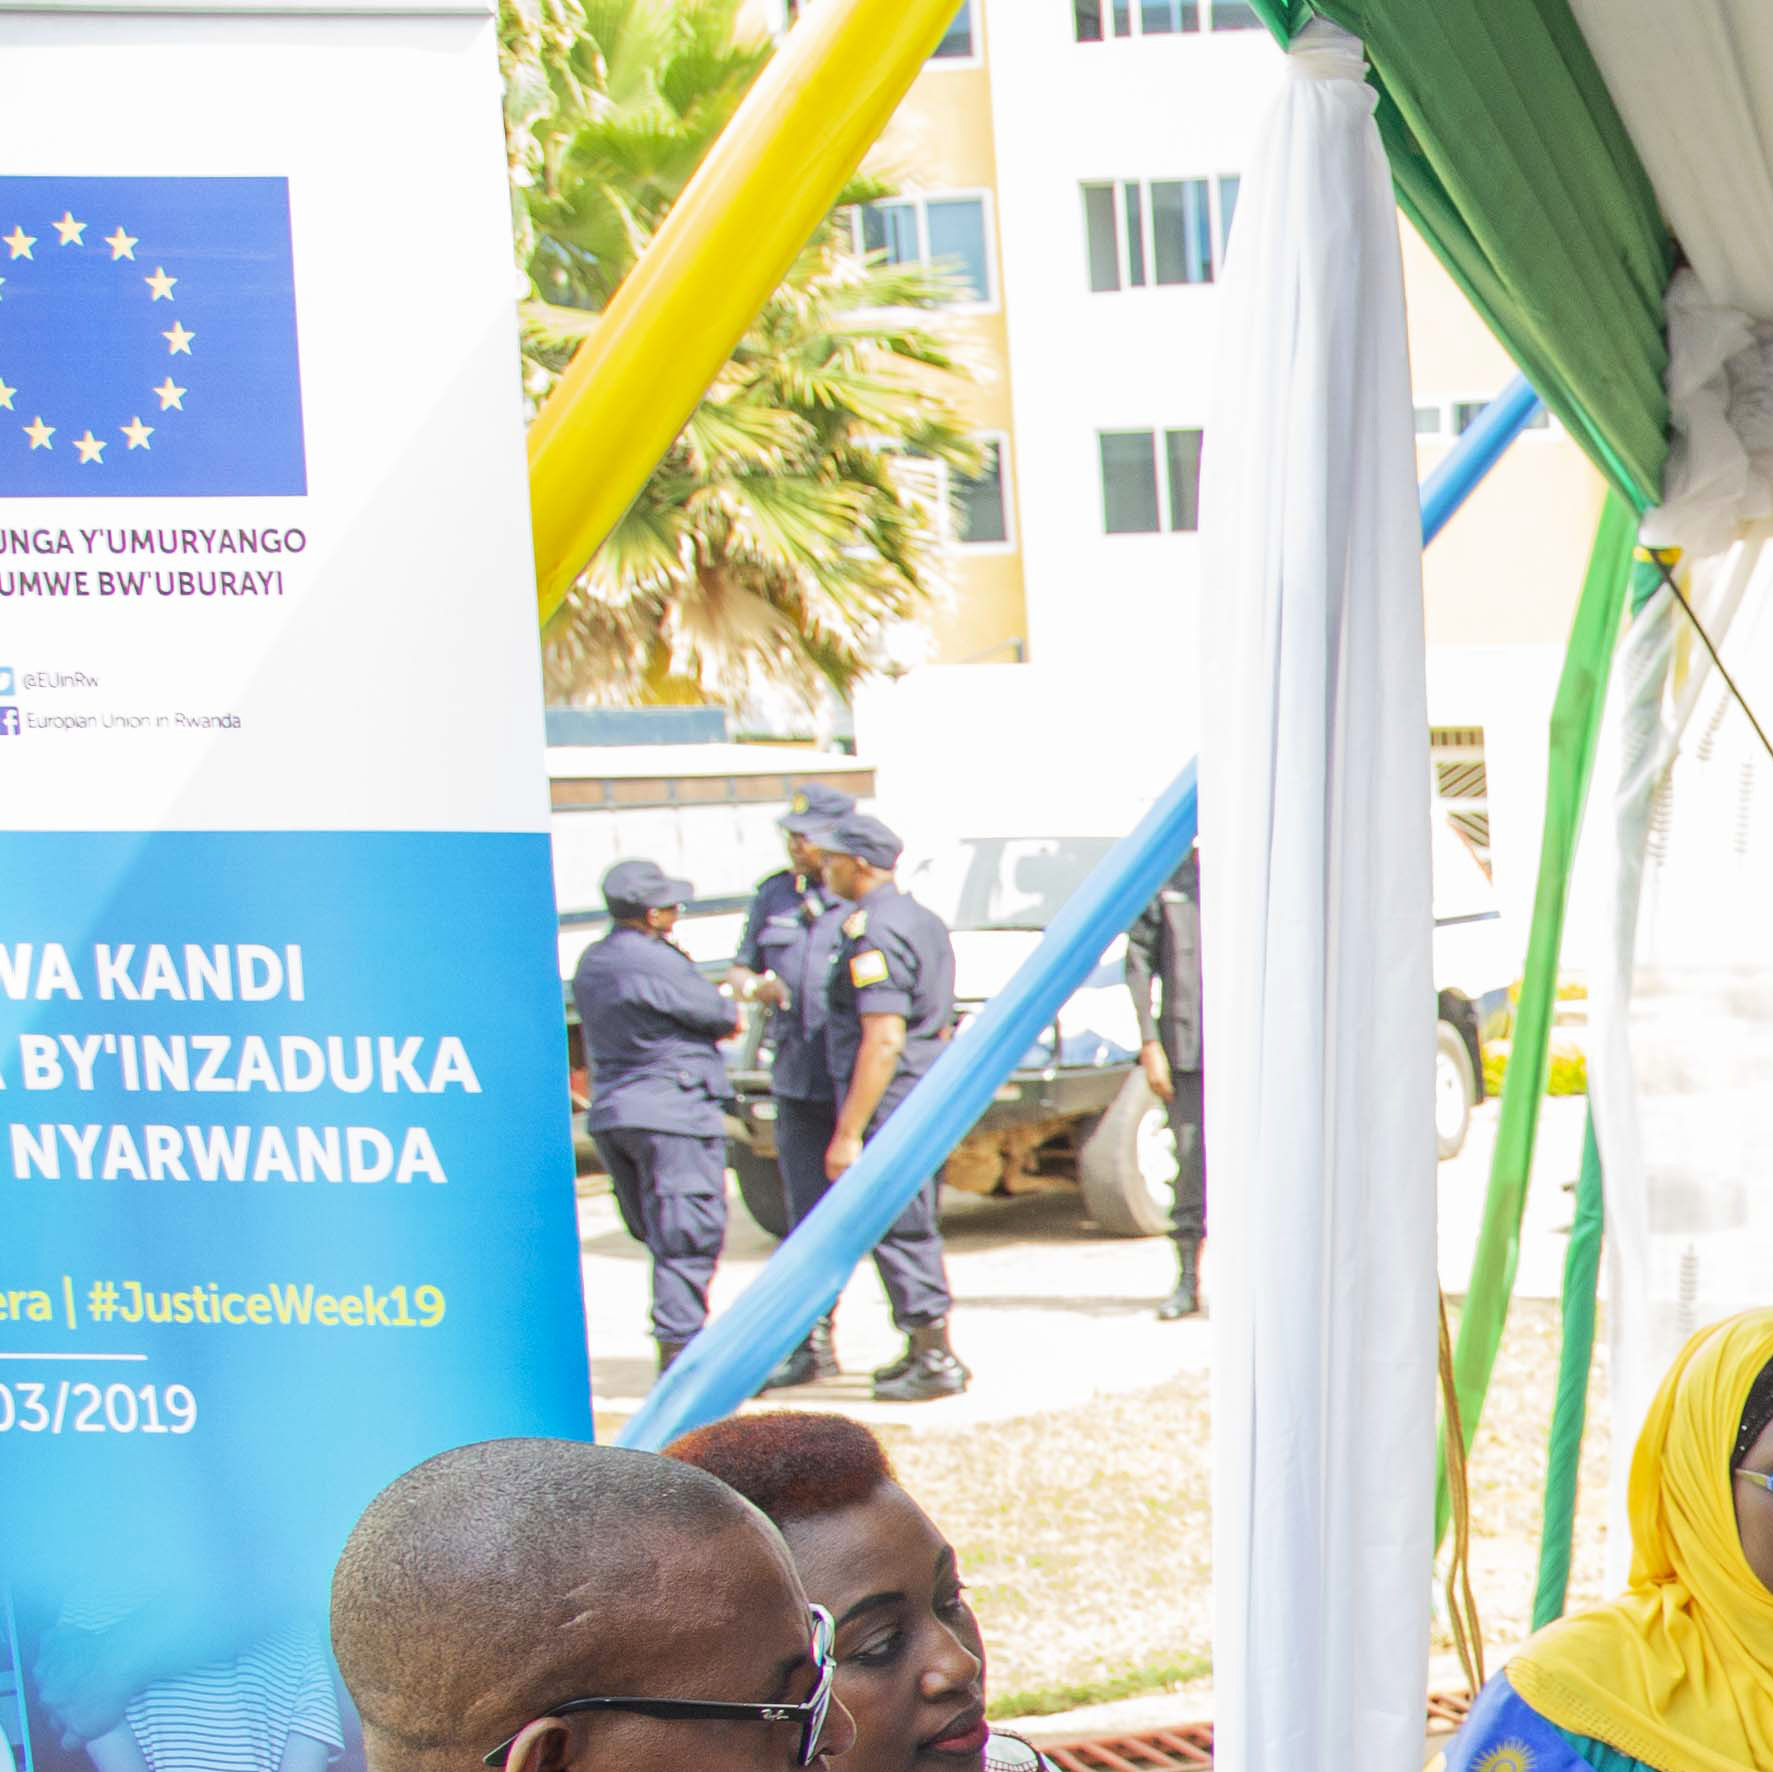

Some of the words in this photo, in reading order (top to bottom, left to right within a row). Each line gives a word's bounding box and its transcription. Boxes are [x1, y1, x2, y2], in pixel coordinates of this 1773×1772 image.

[80, 527, 306, 554] Y'UMURYANGO
[99, 571, 283, 596] BW'UBURAYI
[102, 712, 150, 729] Union
[156, 713, 168, 729] in
[175, 713, 242, 729] Rwanda
[95, 943, 305, 1001] KANDI
[20, 1034, 482, 1093] BY'INZADUKA
[10, 1123, 448, 1185] NYARWANDA
[88, 1280, 446, 1328] #JusticeWeek19
